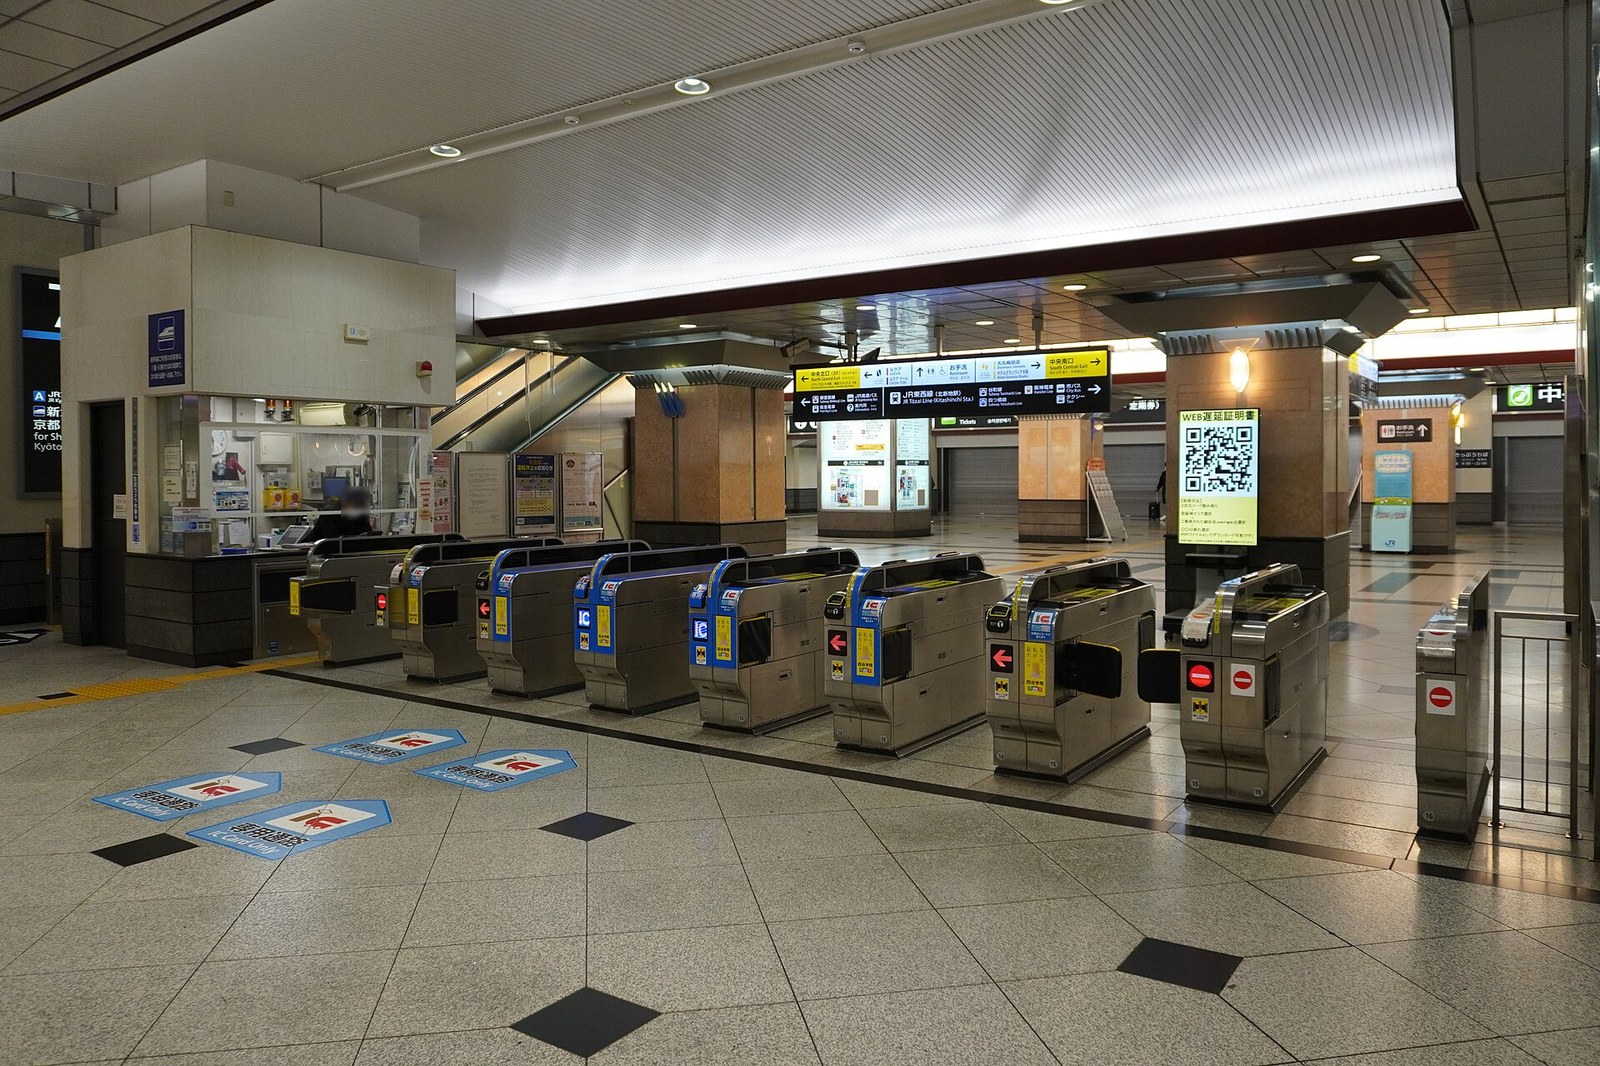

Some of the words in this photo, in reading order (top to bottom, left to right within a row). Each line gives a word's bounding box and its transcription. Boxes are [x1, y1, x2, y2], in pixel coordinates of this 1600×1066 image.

[1049, 357, 1074, 365] 中央南口
[902, 390, 934, 398] JR東西線
[1538, 386, 1565, 404] 中
[47, 406, 62, 418] 新
[1182, 410, 1256, 421] WEB遅延証明書
[33, 419, 61, 431] 京都
[33, 432, 49, 441] for
[724, 591, 738, 599] IC
[578, 611, 591, 628] IC
[1036, 614, 1051, 624] IC
[1425, 812, 1434, 820] 16
[220, 833, 251, 846] Card
[250, 841, 280, 854] Only
